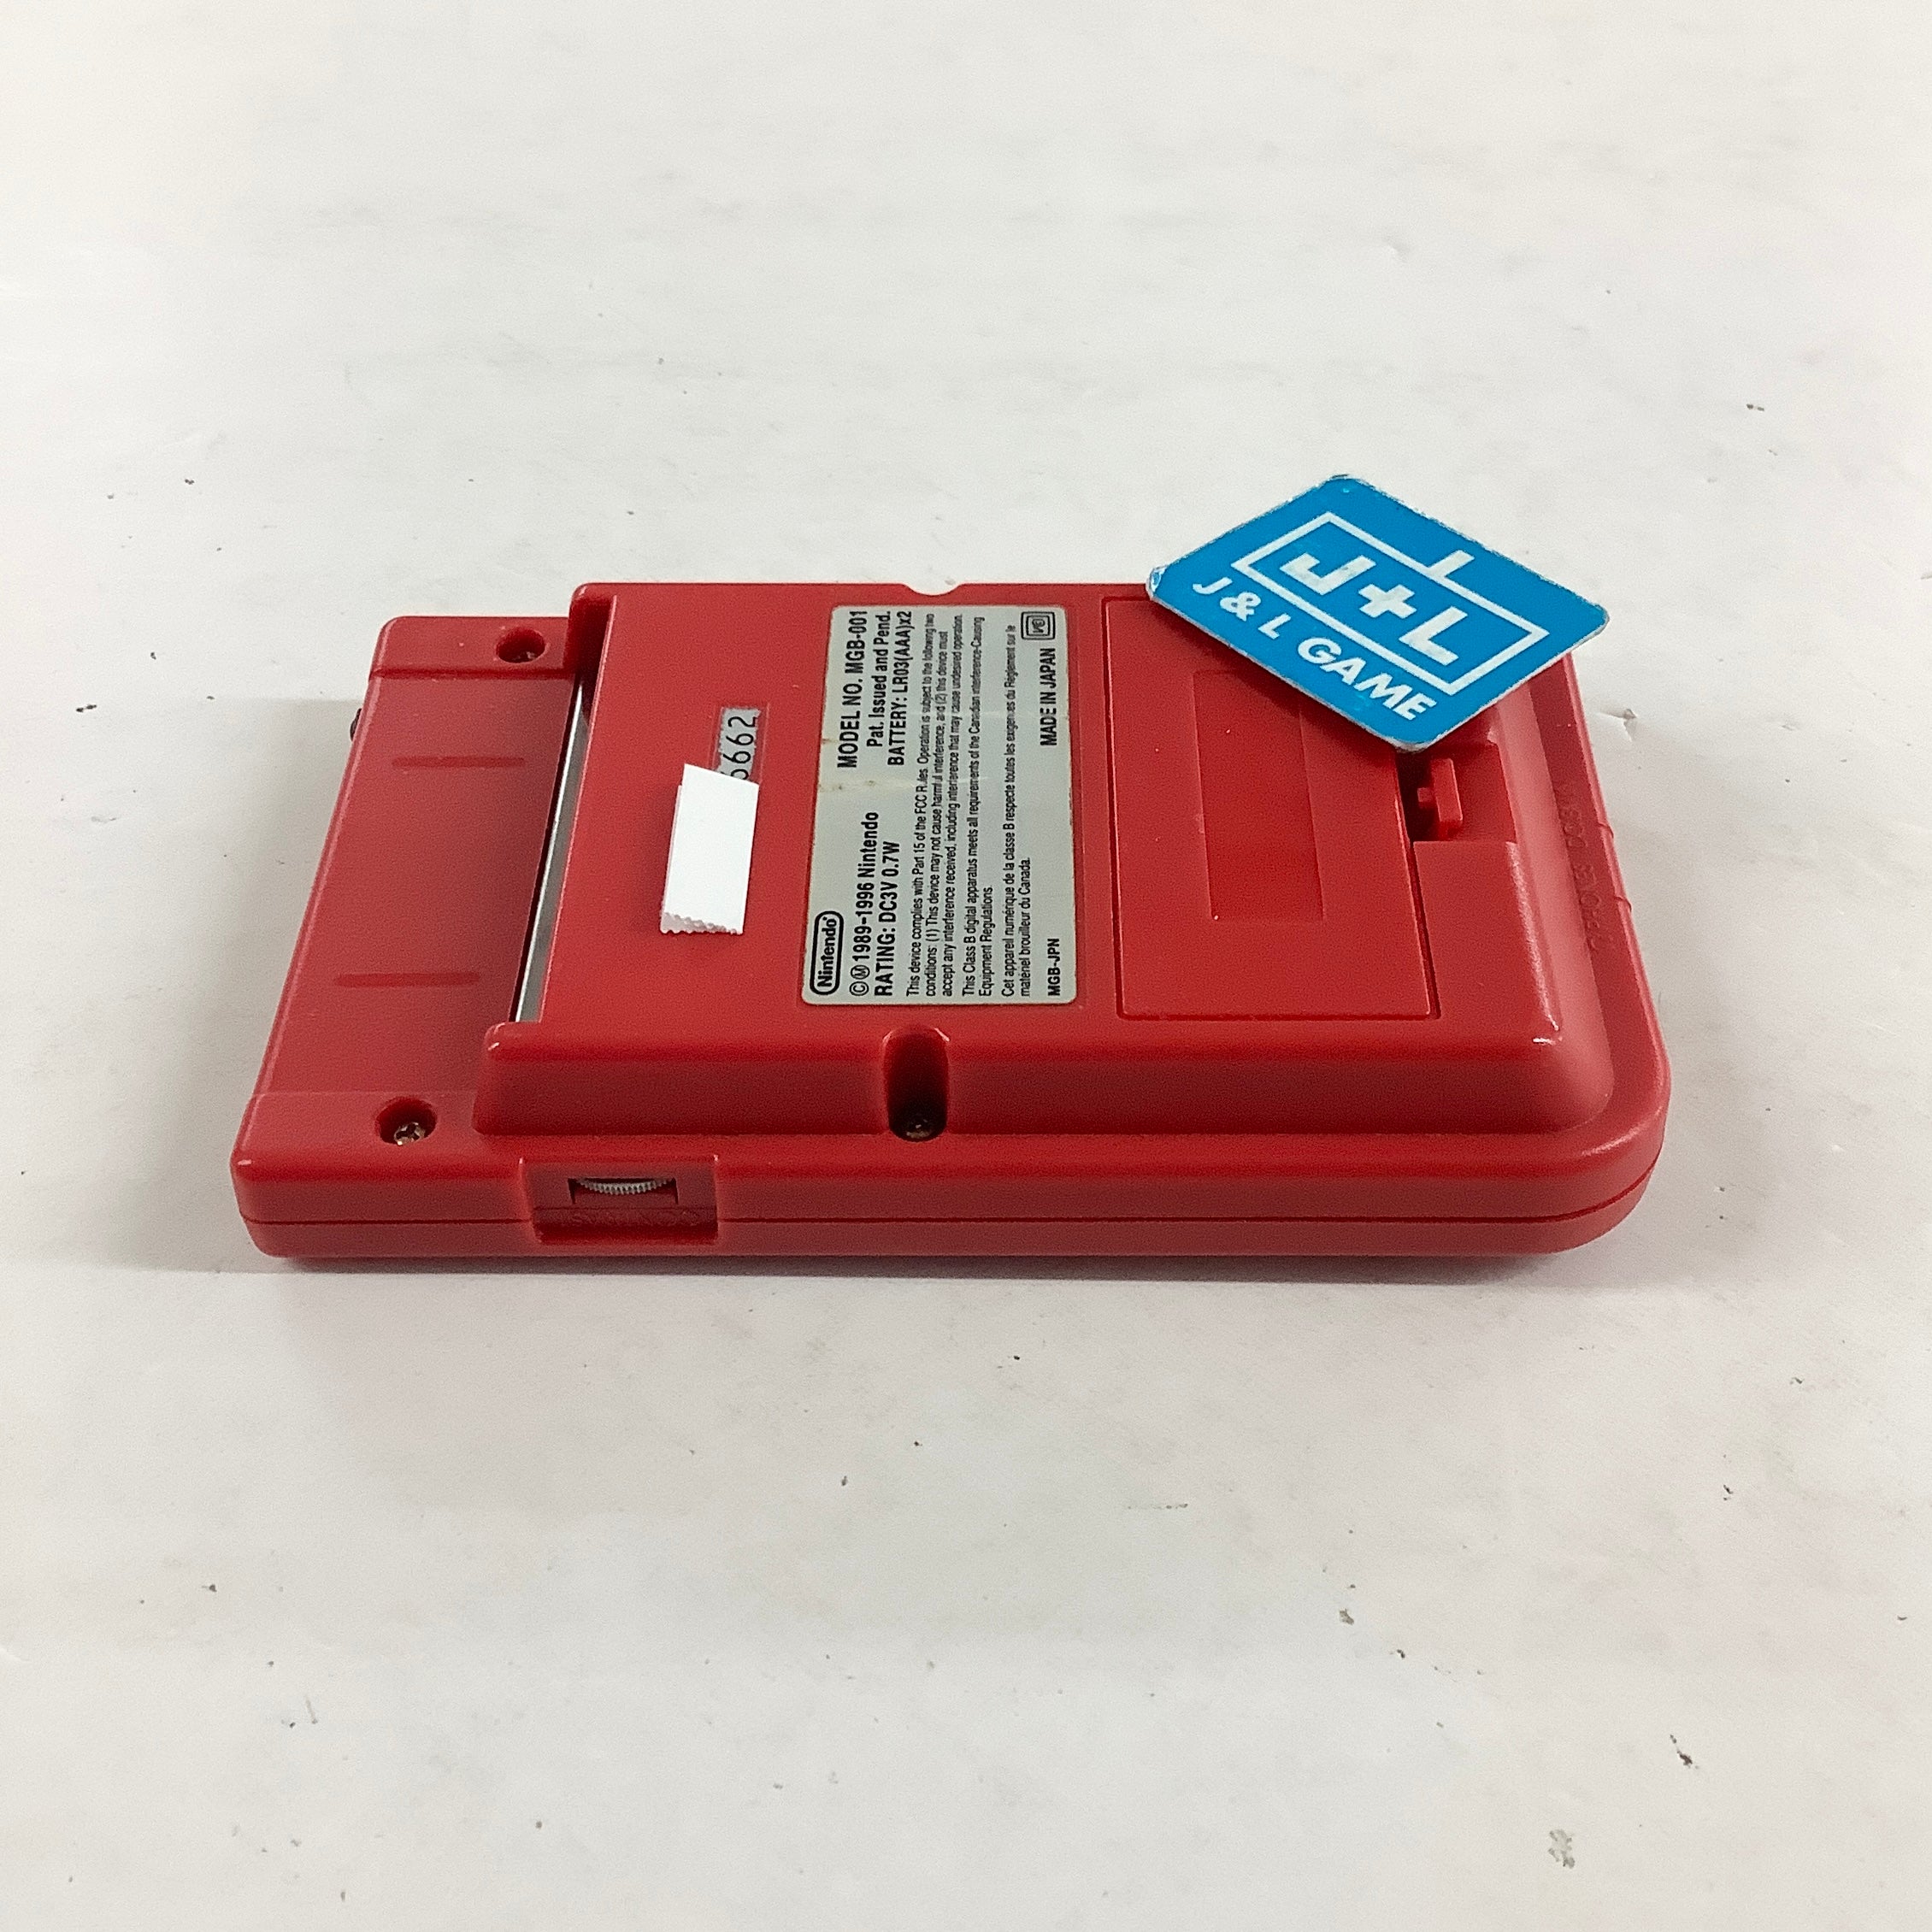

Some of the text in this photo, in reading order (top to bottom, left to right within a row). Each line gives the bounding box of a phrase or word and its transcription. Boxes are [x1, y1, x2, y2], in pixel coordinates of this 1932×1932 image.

[922, 629, 936, 660] following
[939, 632, 947, 649] must
[1193, 576, 1437, 720] J & L GAME
[922, 663, 932, 674] the
[936, 652, 947, 675] device
[951, 652, 962, 689] undesired
[838, 611, 868, 768] MODEL NO. MGB-001
[866, 611, 890, 747] Pat. Issued and Pend.
[887, 611, 915, 765] BATTERY: LR03(AAA)x2
[936, 678, 945, 691] this
[922, 686, 934, 713] subject
[936, 693, 947, 704] (2)
[1005, 691, 1015, 699] du
[1040, 648, 1057, 745] MADE IN JAPAN
[951, 716, 962, 733] may
[969, 696, 980, 733] Canadian
[917, 725, 930, 764] Operation
[948, 735, 959, 750] that
[969, 736, 979, 748] the
[1004, 744, 1015, 755] les
[946, 752, 958, 801] interference
[1004, 757, 1015, 782] toutes
[968, 761, 981, 815] requirements
[915, 795, 927, 814] FCC
[1004, 785, 1017, 821] respecte
[914, 816, 926, 829] the
[932, 810, 942, 834] cause
[944, 804, 960, 841] including
[967, 817, 978, 827] all
[857, 812, 879, 877] Nintendo
[913, 844, 925, 852] 15
[930, 837, 941, 851] not
[968, 829, 978, 856] meets
[1004, 833, 1014, 860] classe
[912, 857, 925, 875] Part
[930, 853, 943, 872] may
[1018, 857, 1030, 894] Canada.
[912, 878, 922, 895] with
[927, 875, 939, 904] device
[966, 858, 978, 903] apparatus
[1003, 874, 1014, 884] de
[926, 906, 938, 926] This
[942, 887, 955, 941] interference
[1002, 887, 1017, 935] numérique
[1018, 898, 1030, 909] du
[852, 883, 875, 961] 1989-1996
[875, 841, 899, 996] RATING: DC3V 0.7W
[910, 898, 924, 939] complies
[964, 906, 979, 934] digital
[926, 929, 940, 942] (1)
[1018, 911, 1030, 955] brouilleur
[817, 918, 837, 987] Nintendo
[908, 942, 922, 973] device
[942, 944, 956, 962] any
[963, 946, 975, 973] Class
[1002, 939, 1016, 976] appareil
[942, 964, 955, 996] accept
[979, 945, 994, 996] Equipment
[1048, 939, 1060, 996] MGB-JPN
[906, 976, 920, 997] This
[963, 976, 975, 997] This
[1002, 980, 1014, 997] Cet
